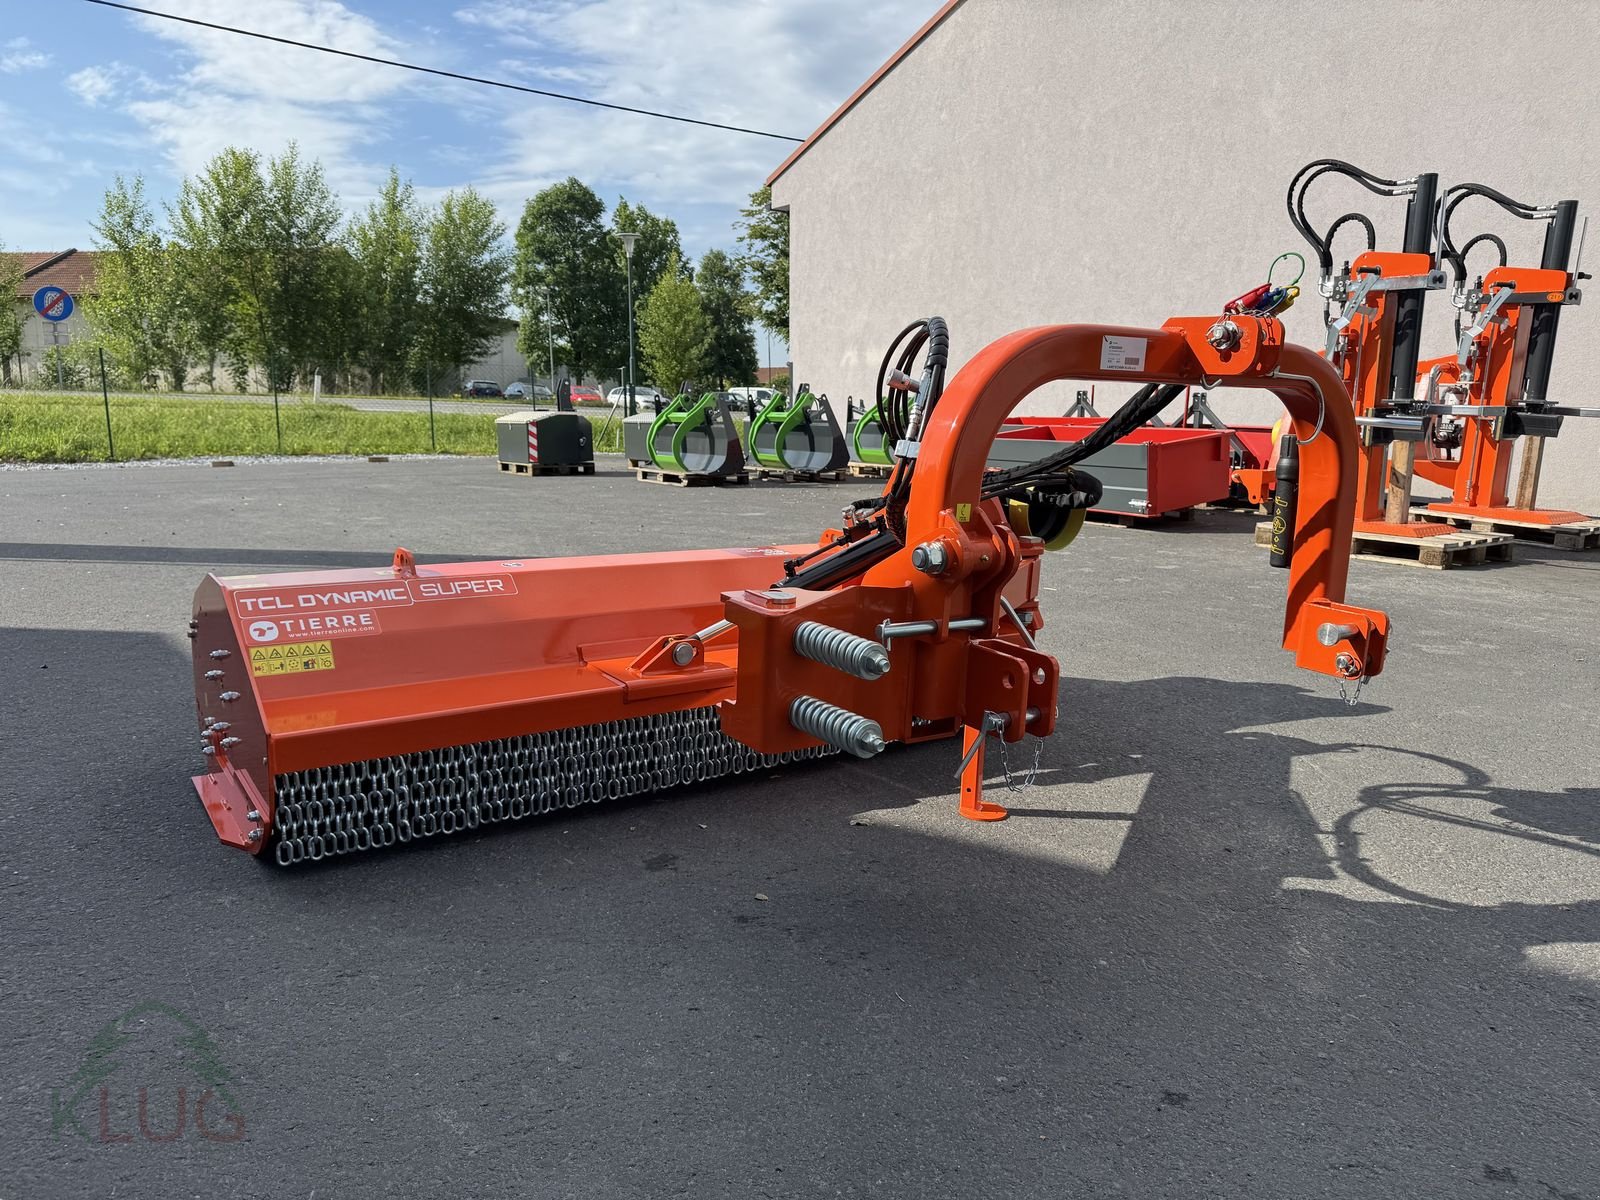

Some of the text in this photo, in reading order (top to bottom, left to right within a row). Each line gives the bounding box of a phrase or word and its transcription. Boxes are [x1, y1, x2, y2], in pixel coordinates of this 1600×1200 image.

[240, 579, 505, 611] TCL DYNAMIC SUPER
[280, 614, 373, 631] TIERRE
[288, 625, 375, 638] www.tierreonline.com
